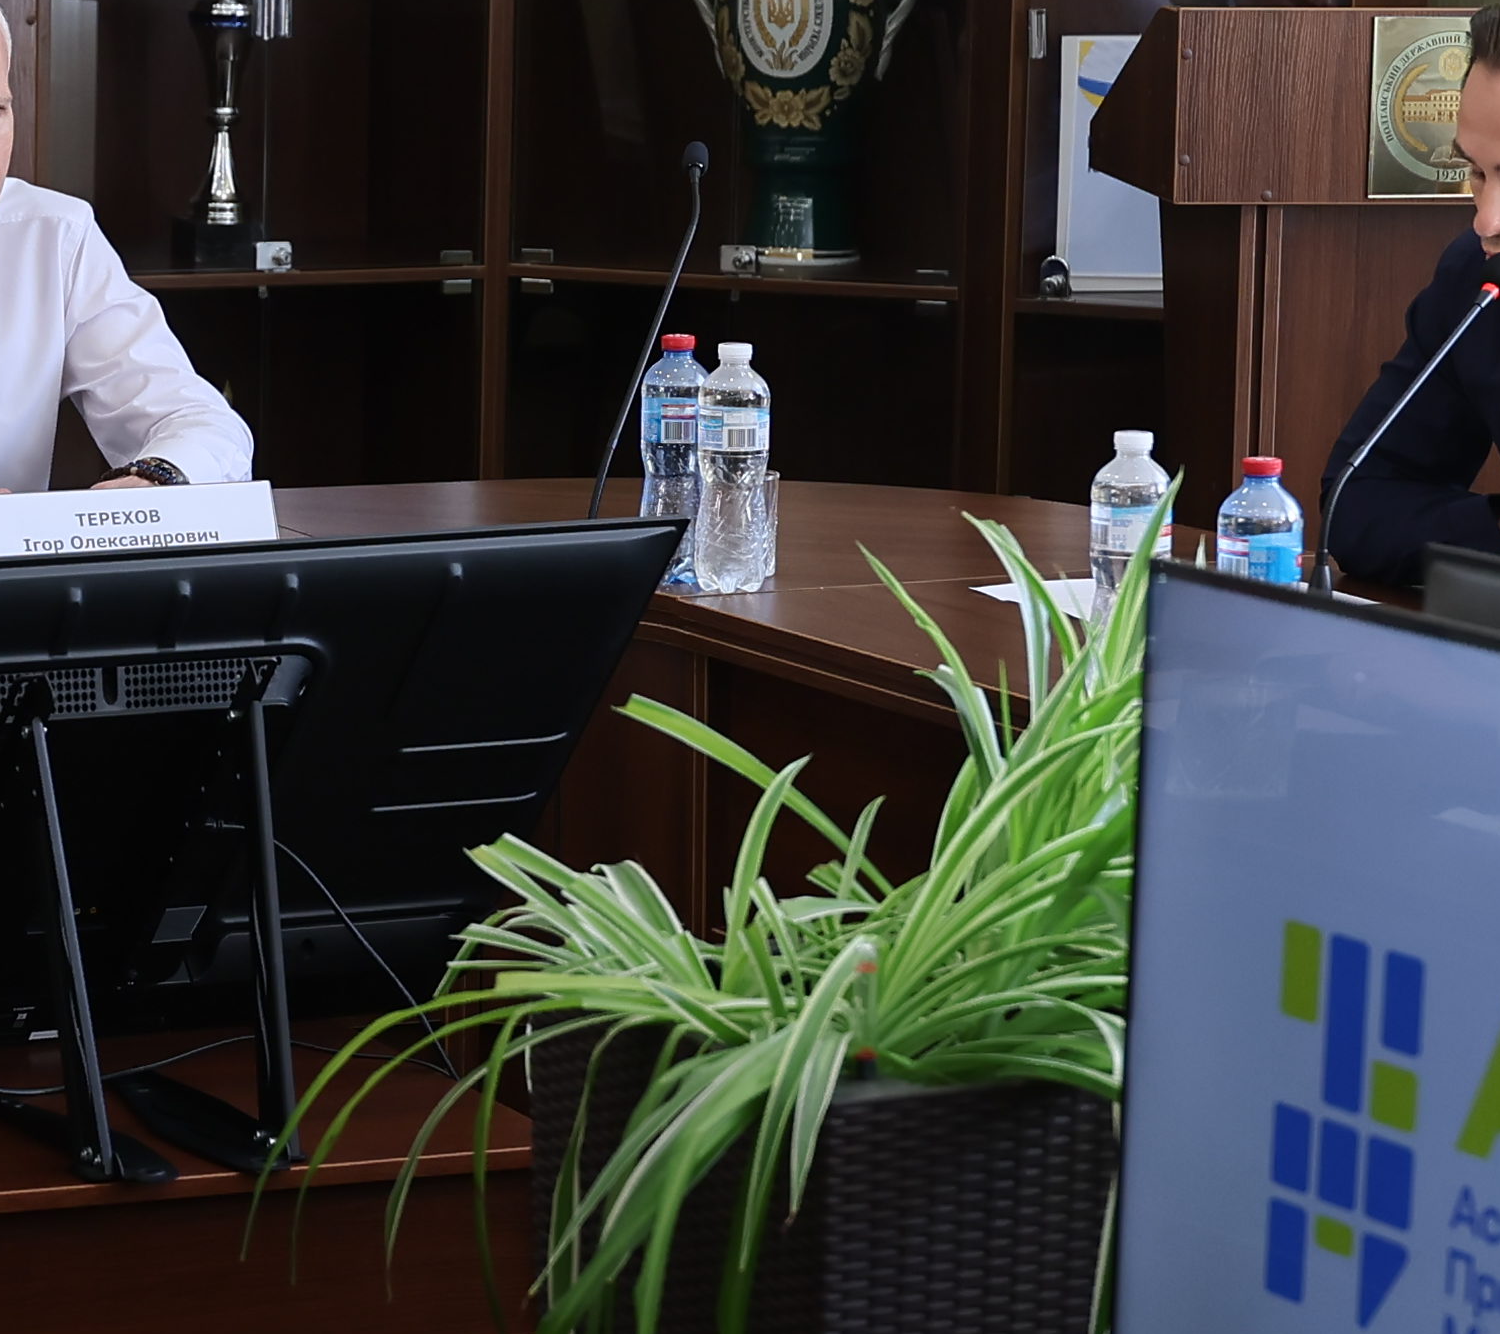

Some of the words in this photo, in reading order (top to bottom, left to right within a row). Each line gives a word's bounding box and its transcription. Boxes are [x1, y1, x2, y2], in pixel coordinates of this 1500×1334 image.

[1435, 169, 1466, 181] 1920
[75, 509, 161, 527] ТЕРЕХОВ
[23, 538, 65, 554] Ігор
[70, 530, 220, 550] Олександрович
